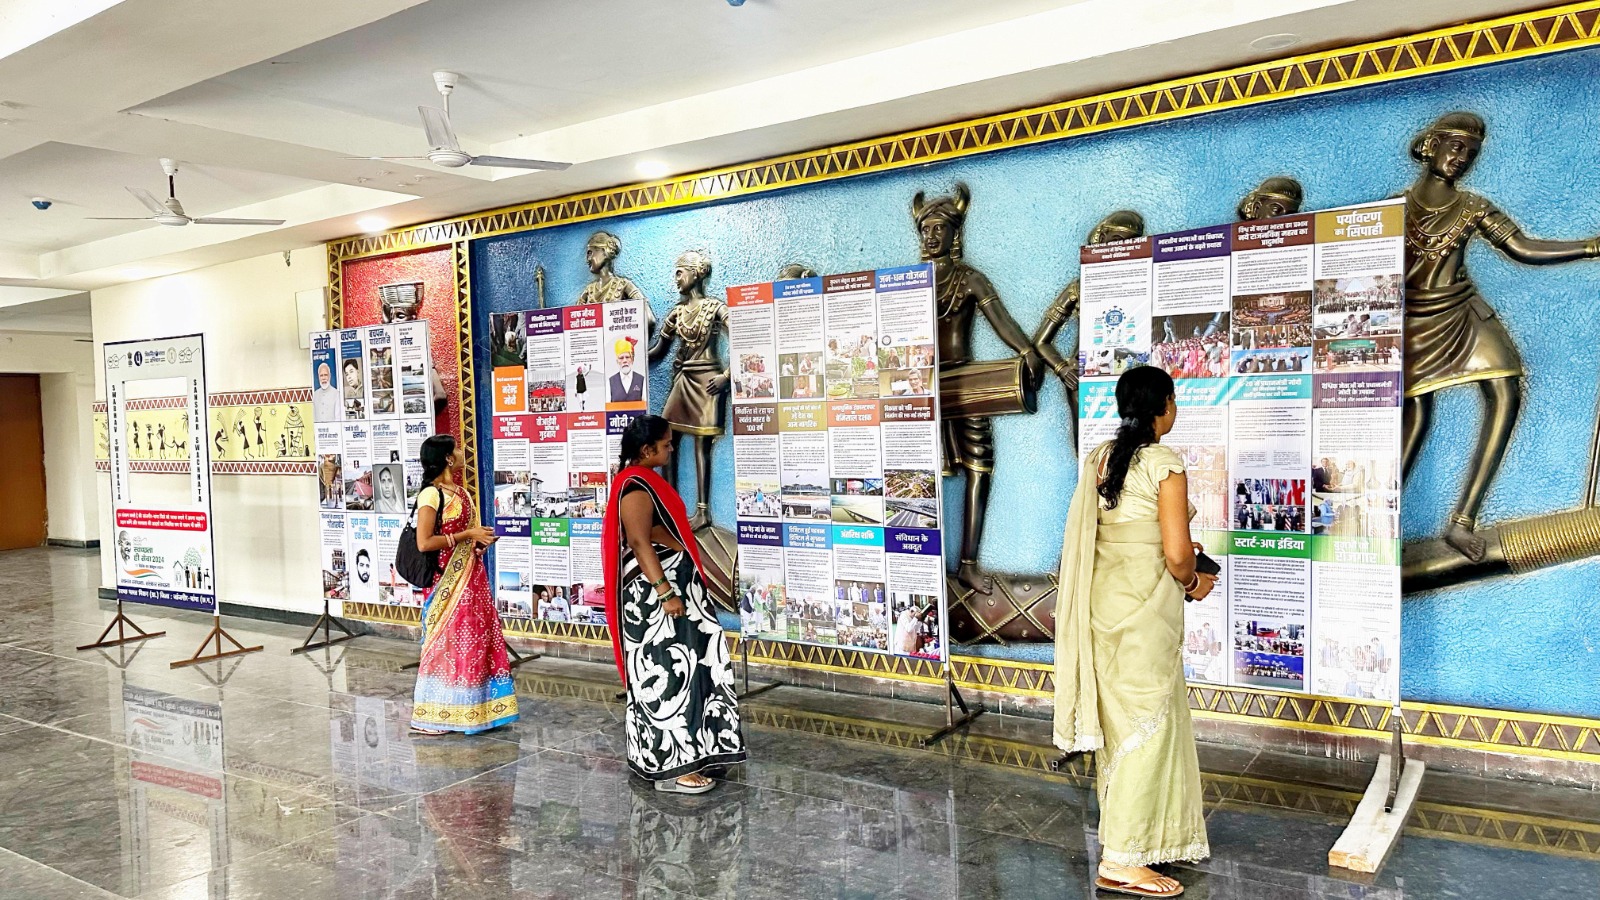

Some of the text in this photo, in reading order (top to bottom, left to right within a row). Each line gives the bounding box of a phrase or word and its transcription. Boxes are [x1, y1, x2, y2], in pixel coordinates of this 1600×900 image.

[1336, 211, 1382, 225] पर्यावरण
[1346, 222, 1383, 237] सिपाही
[879, 270, 927, 282] जन-धन योजना
[581, 318, 596, 327] विकास
[340, 330, 357, 340] बचपन
[314, 333, 331, 350] मोदी
[609, 414, 628, 427] मोदी
[405, 422, 427, 433] देशभक्ति
[378, 516, 399, 528] हिमालय
[592, 521, 602, 530] इंडि
[841, 529, 874, 539] अंतरिक्ष शक्ति
[895, 533, 928, 542] संविधान के
[902, 543, 922, 552] अग्रदूत
[1234, 536, 1305, 550] स्टार्ट-अप इंडिया
[134, 553, 140, 562] ही
[1334, 552, 1377, 564] रोजगार
